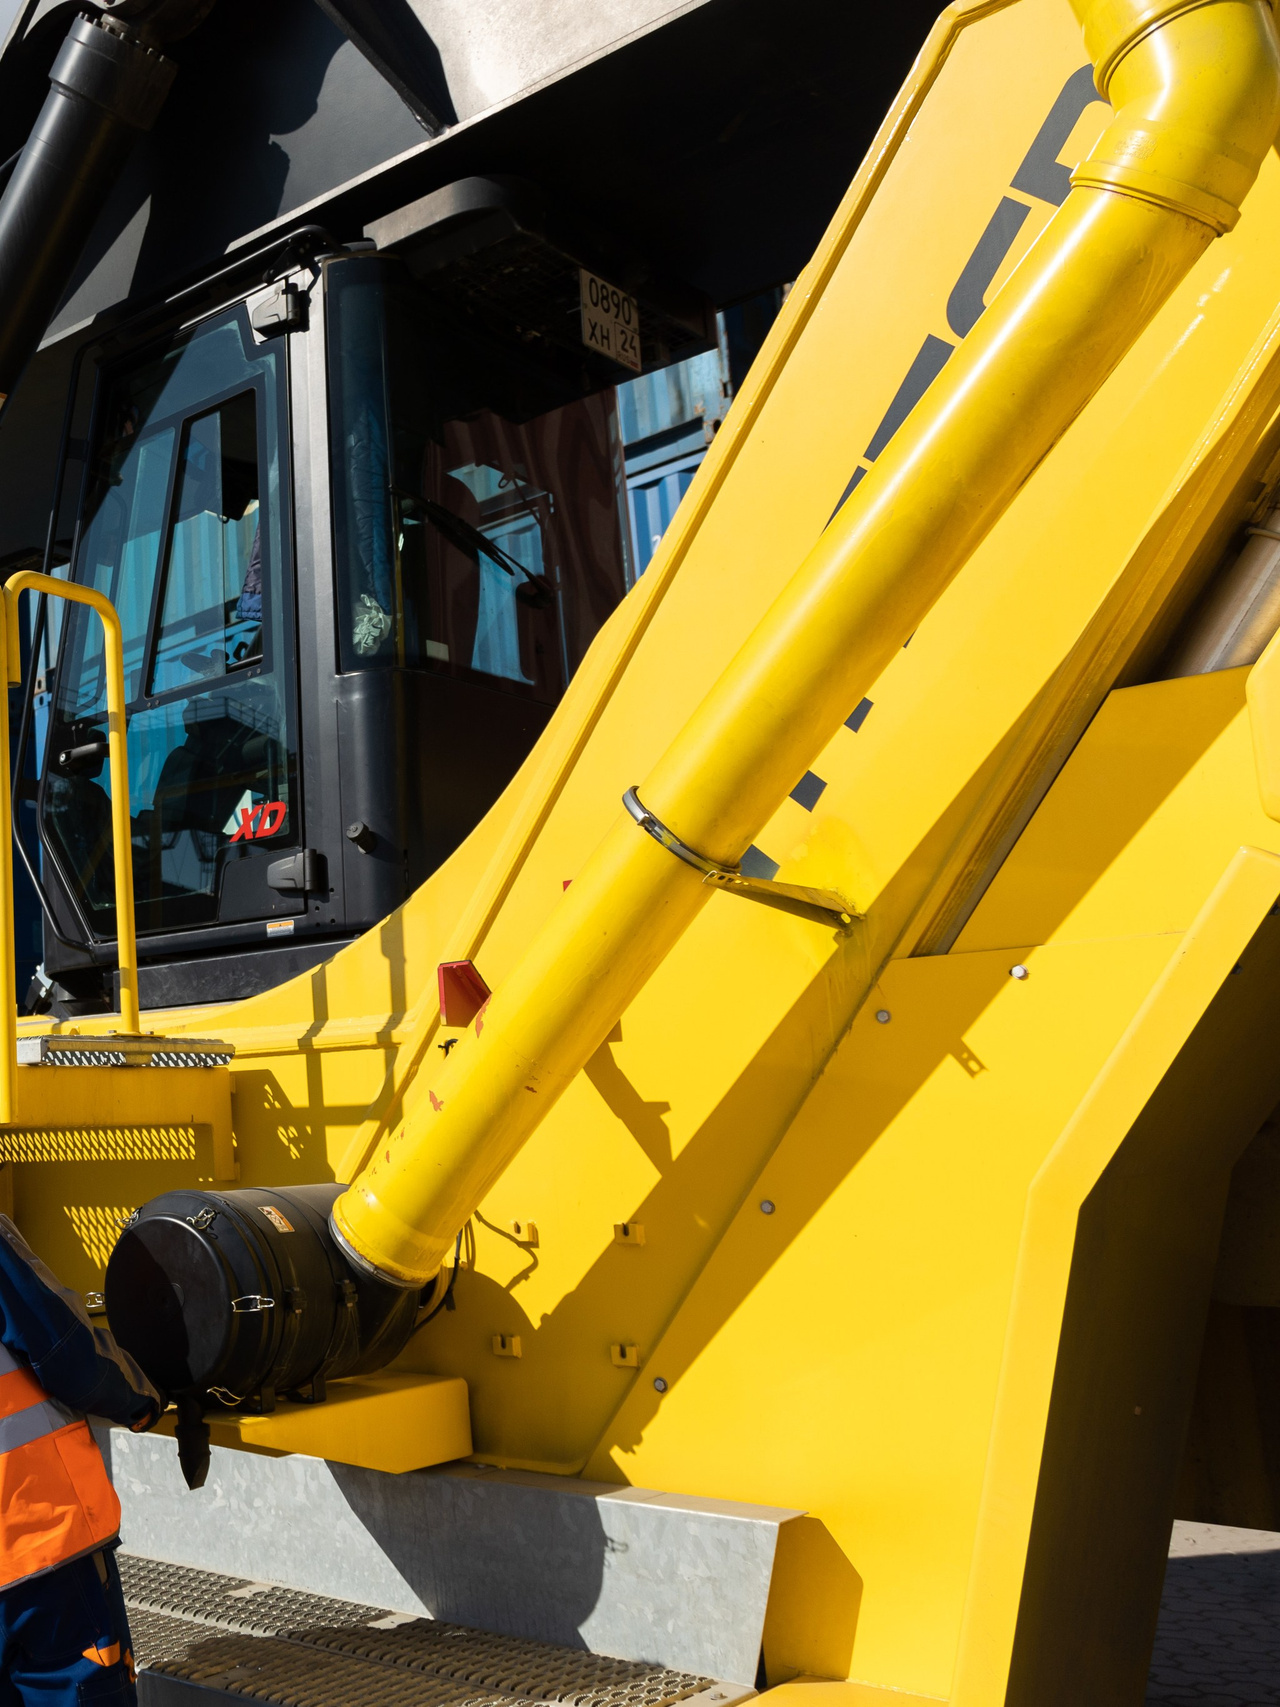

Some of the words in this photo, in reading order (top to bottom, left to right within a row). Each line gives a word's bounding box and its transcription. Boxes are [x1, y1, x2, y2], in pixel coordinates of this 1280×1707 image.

[589, 277, 631, 326] 0890
[620, 329, 638, 358] 24
[229, 801, 287, 843] XD
